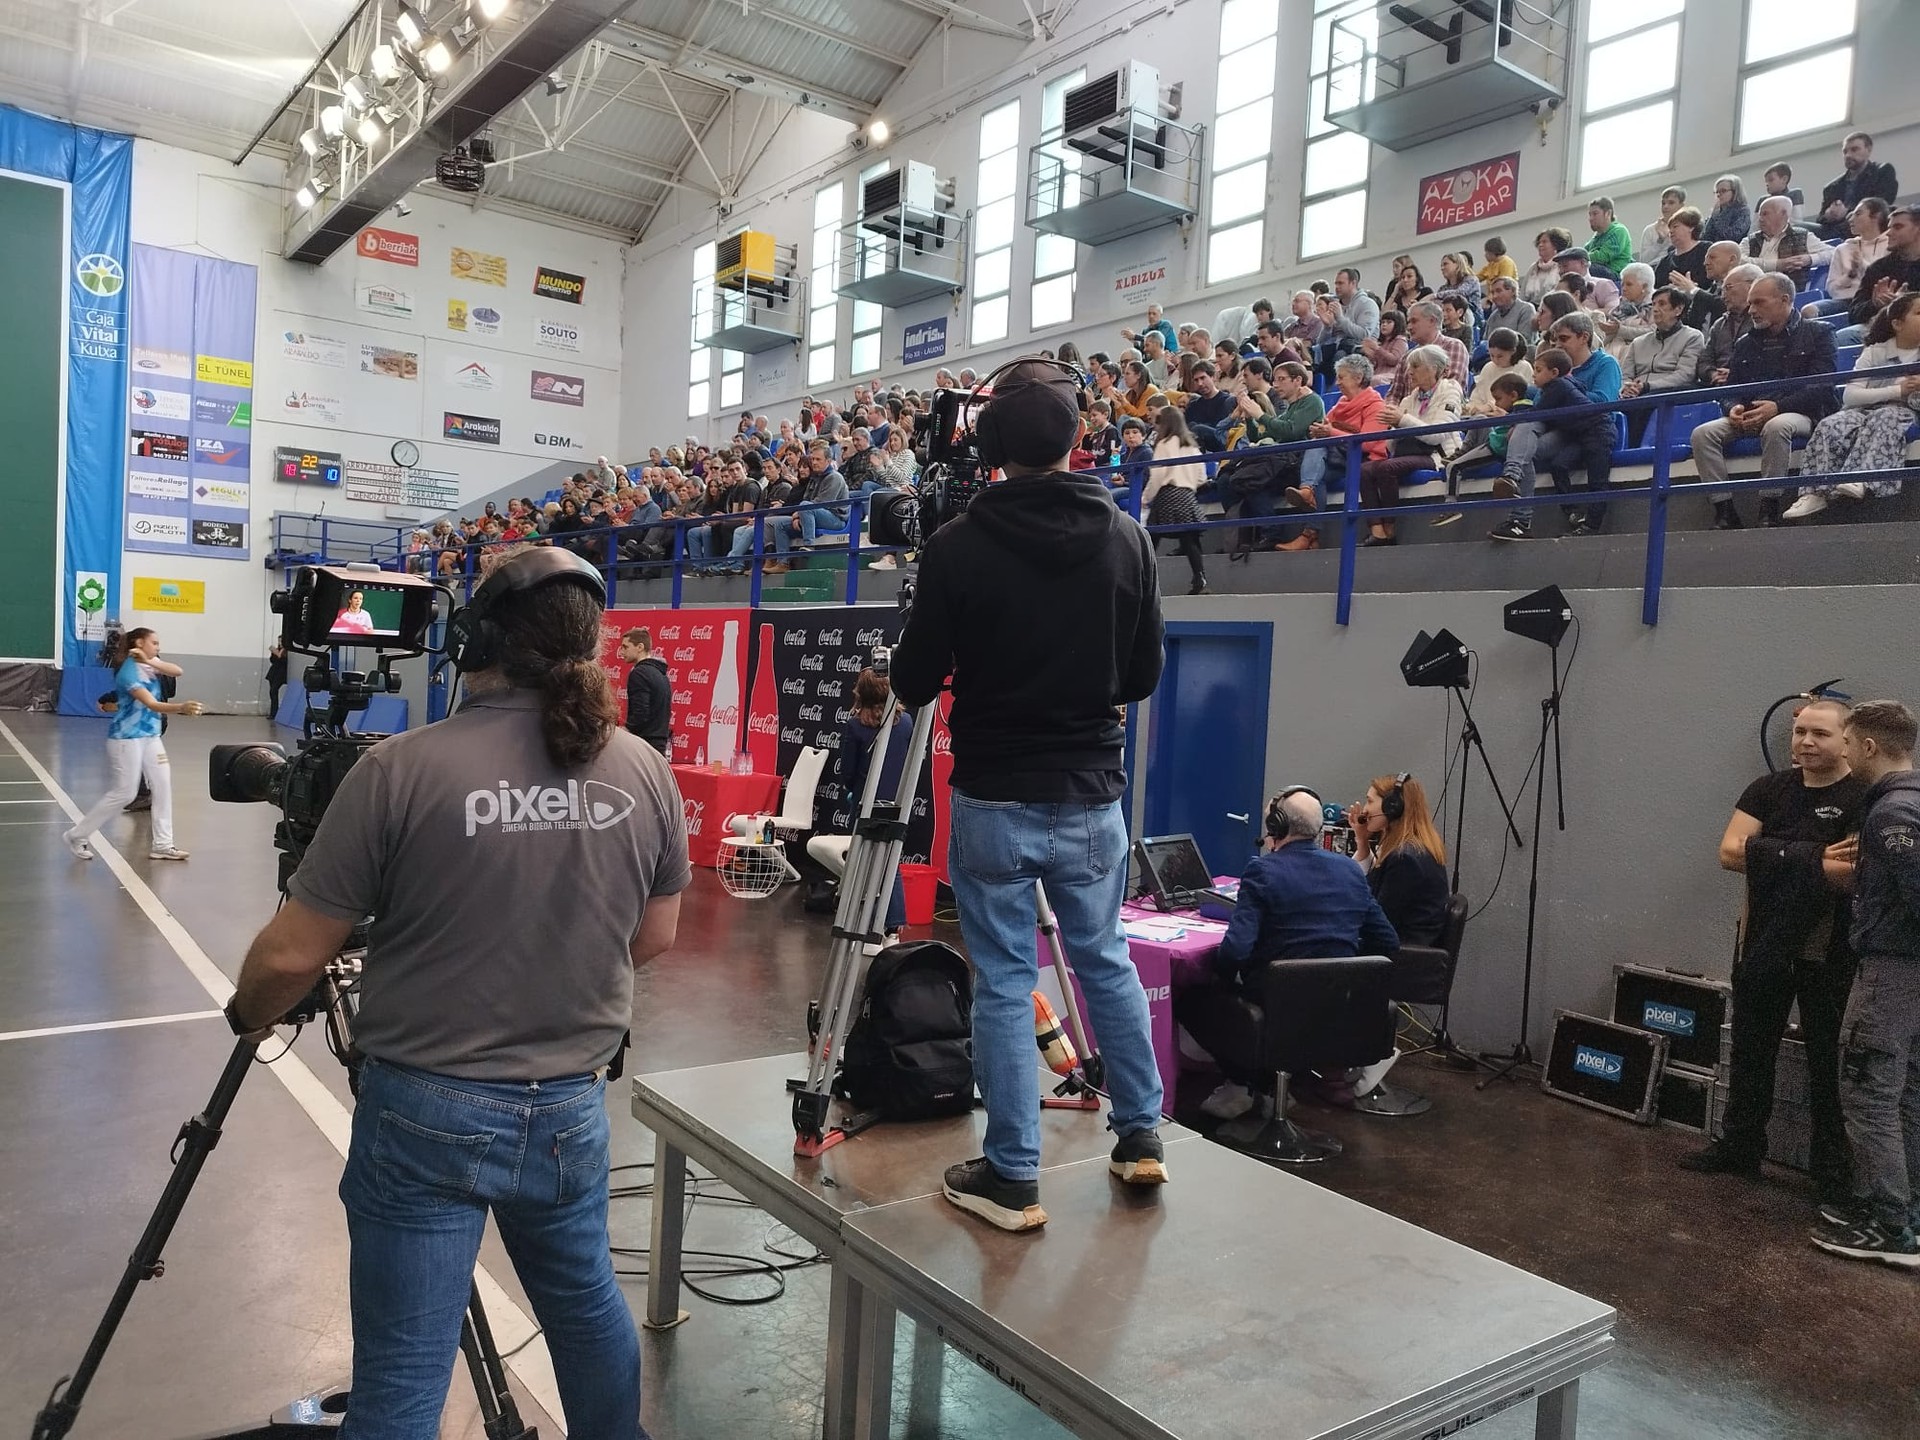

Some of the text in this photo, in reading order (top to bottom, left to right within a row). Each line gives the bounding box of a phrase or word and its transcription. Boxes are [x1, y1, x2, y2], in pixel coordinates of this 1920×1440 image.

[1421, 185, 1512, 224] KAFE-BAR
[539, 275, 582, 292] MUNDO
[1115, 267, 1166, 291] ALBIZUA
[86, 310, 115, 327] Caja
[80, 325, 119, 343] Vital
[540, 325, 578, 340] SOUTO
[80, 342, 118, 359] Kutxa
[198, 363, 251, 379] EL TÚNEL
[463, 421, 499, 434] Arakaldo
[196, 438, 224, 449] IZA
[549, 435, 571, 448] BM
[301, 454, 318, 468] 22
[346, 462, 402, 474] ARRIZABALAGA
[327, 468, 338, 481] 10
[353, 492, 401, 503] MENDIZABAL
[202, 521, 230, 529] BODEGA
[465, 778, 581, 837] pixel
[554, 820, 589, 831] TELEBISTA
[1644, 1006, 1677, 1024] pixel
[1576, 1051, 1607, 1072] pixel
